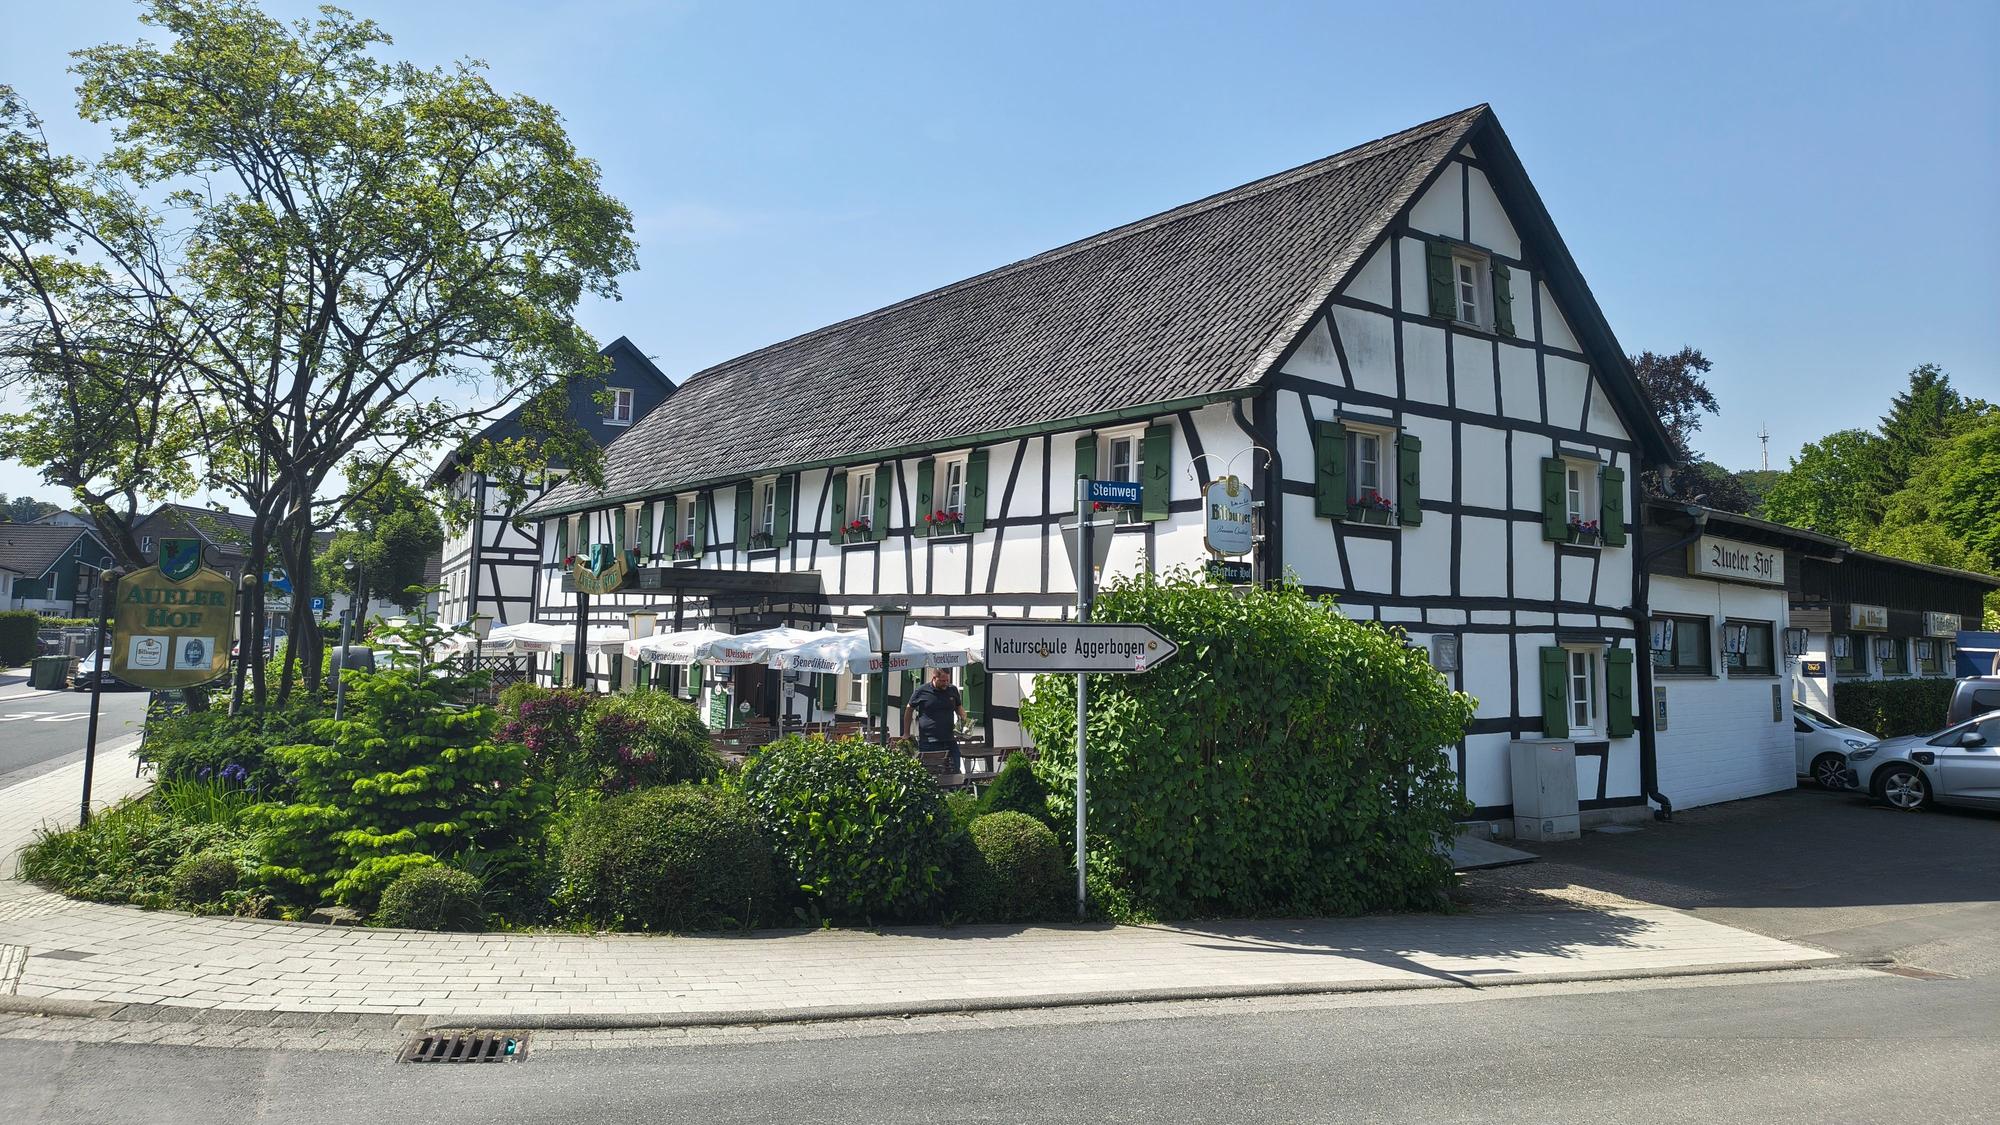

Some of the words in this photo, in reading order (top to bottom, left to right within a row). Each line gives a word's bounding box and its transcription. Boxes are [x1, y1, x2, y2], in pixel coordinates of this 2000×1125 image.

[1093, 483, 1137, 501] Steinweg
[1211, 504, 1251, 525] Bitburger
[1712, 544, 1750, 571] Aueler
[1753, 551, 1774, 579] Hof
[123, 585, 225, 606] AUELER
[313, 599, 322, 608] P
[144, 607, 203, 628] HOF
[650, 650, 689, 662] Benediktiner
[724, 647, 755, 660] Weissbier
[994, 637, 1068, 655] Naturschule
[1074, 637, 1146, 659] Aggerbogen
[792, 655, 838, 670] Benediktiner
[868, 658, 909, 671] Wesbier
